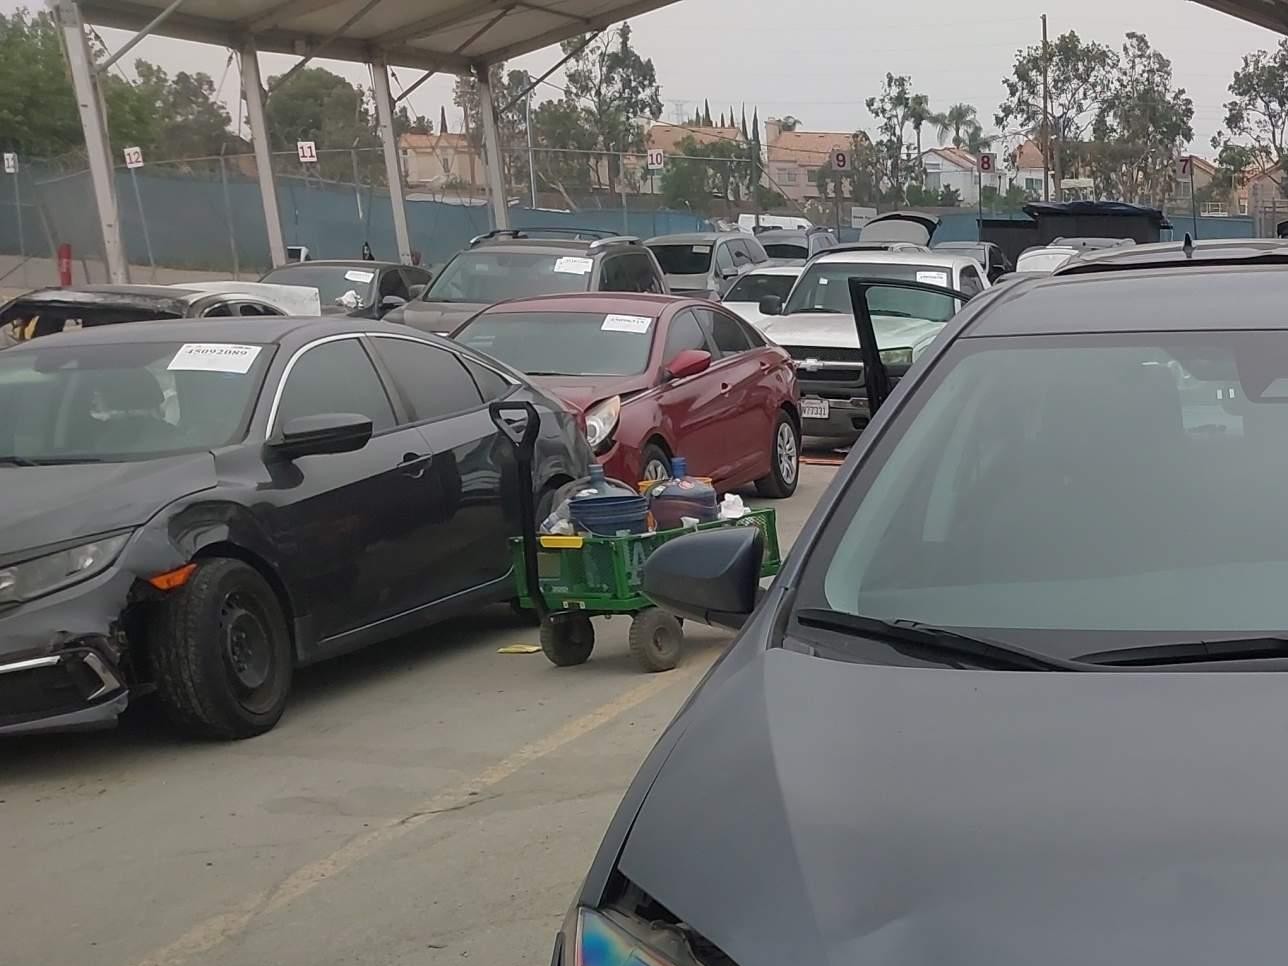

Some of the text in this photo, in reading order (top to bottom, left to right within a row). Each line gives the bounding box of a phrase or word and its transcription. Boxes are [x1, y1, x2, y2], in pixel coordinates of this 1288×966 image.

[127, 151, 142, 164] 12
[299, 145, 315, 158] 11
[648, 153, 663, 165] 10
[836, 153, 846, 168] 9
[981, 155, 991, 170] 8
[1179, 159, 1189, 174] 7
